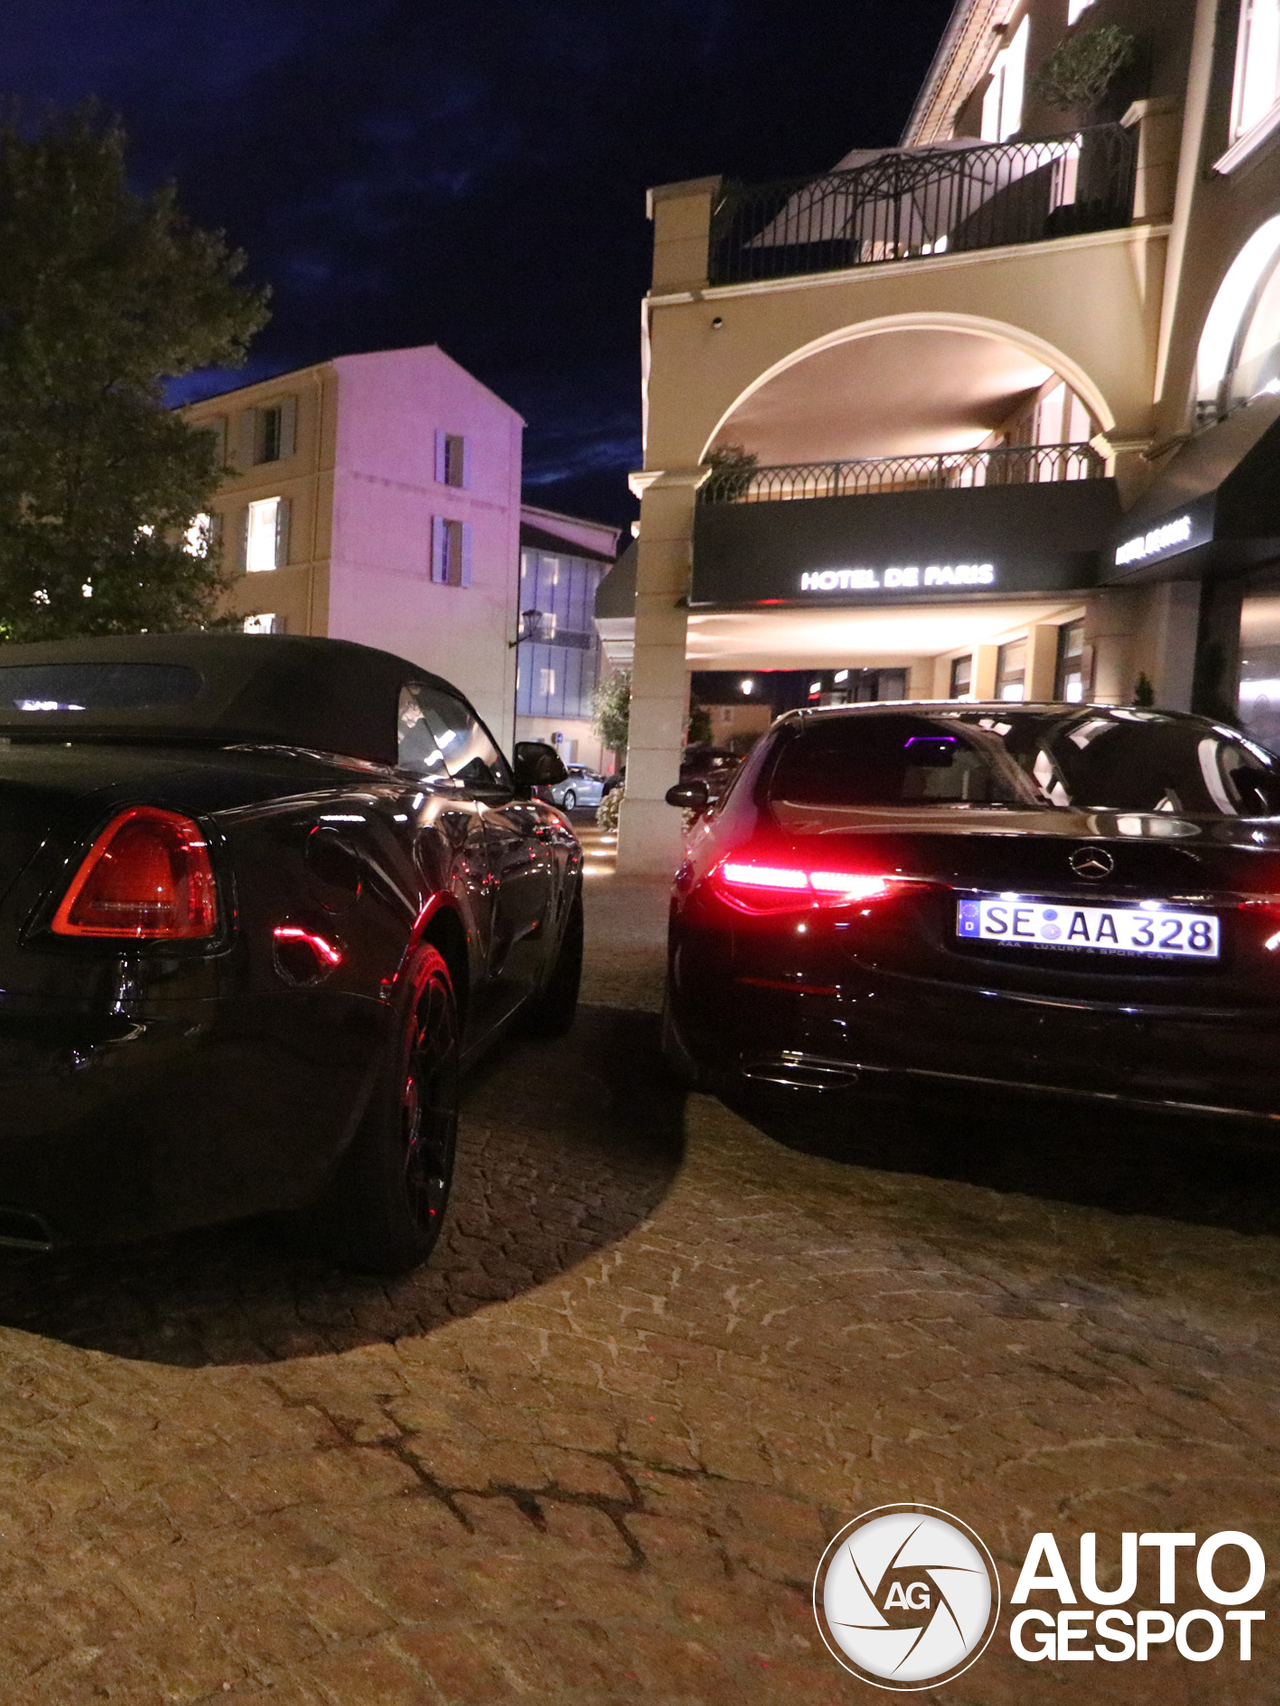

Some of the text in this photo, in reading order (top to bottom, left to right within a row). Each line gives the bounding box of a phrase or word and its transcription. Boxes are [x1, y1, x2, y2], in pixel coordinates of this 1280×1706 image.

[801, 564, 994, 591] HOTEL DE PARIS
[965, 922, 973, 931] D
[985, 907, 1212, 951] SE AA 328
[997, 940, 1021, 948] AAA
[1033, 943, 1082, 953] LUXURY
[1099, 949, 1142, 958] SPORT
[1147, 952, 1174, 961] CAR
